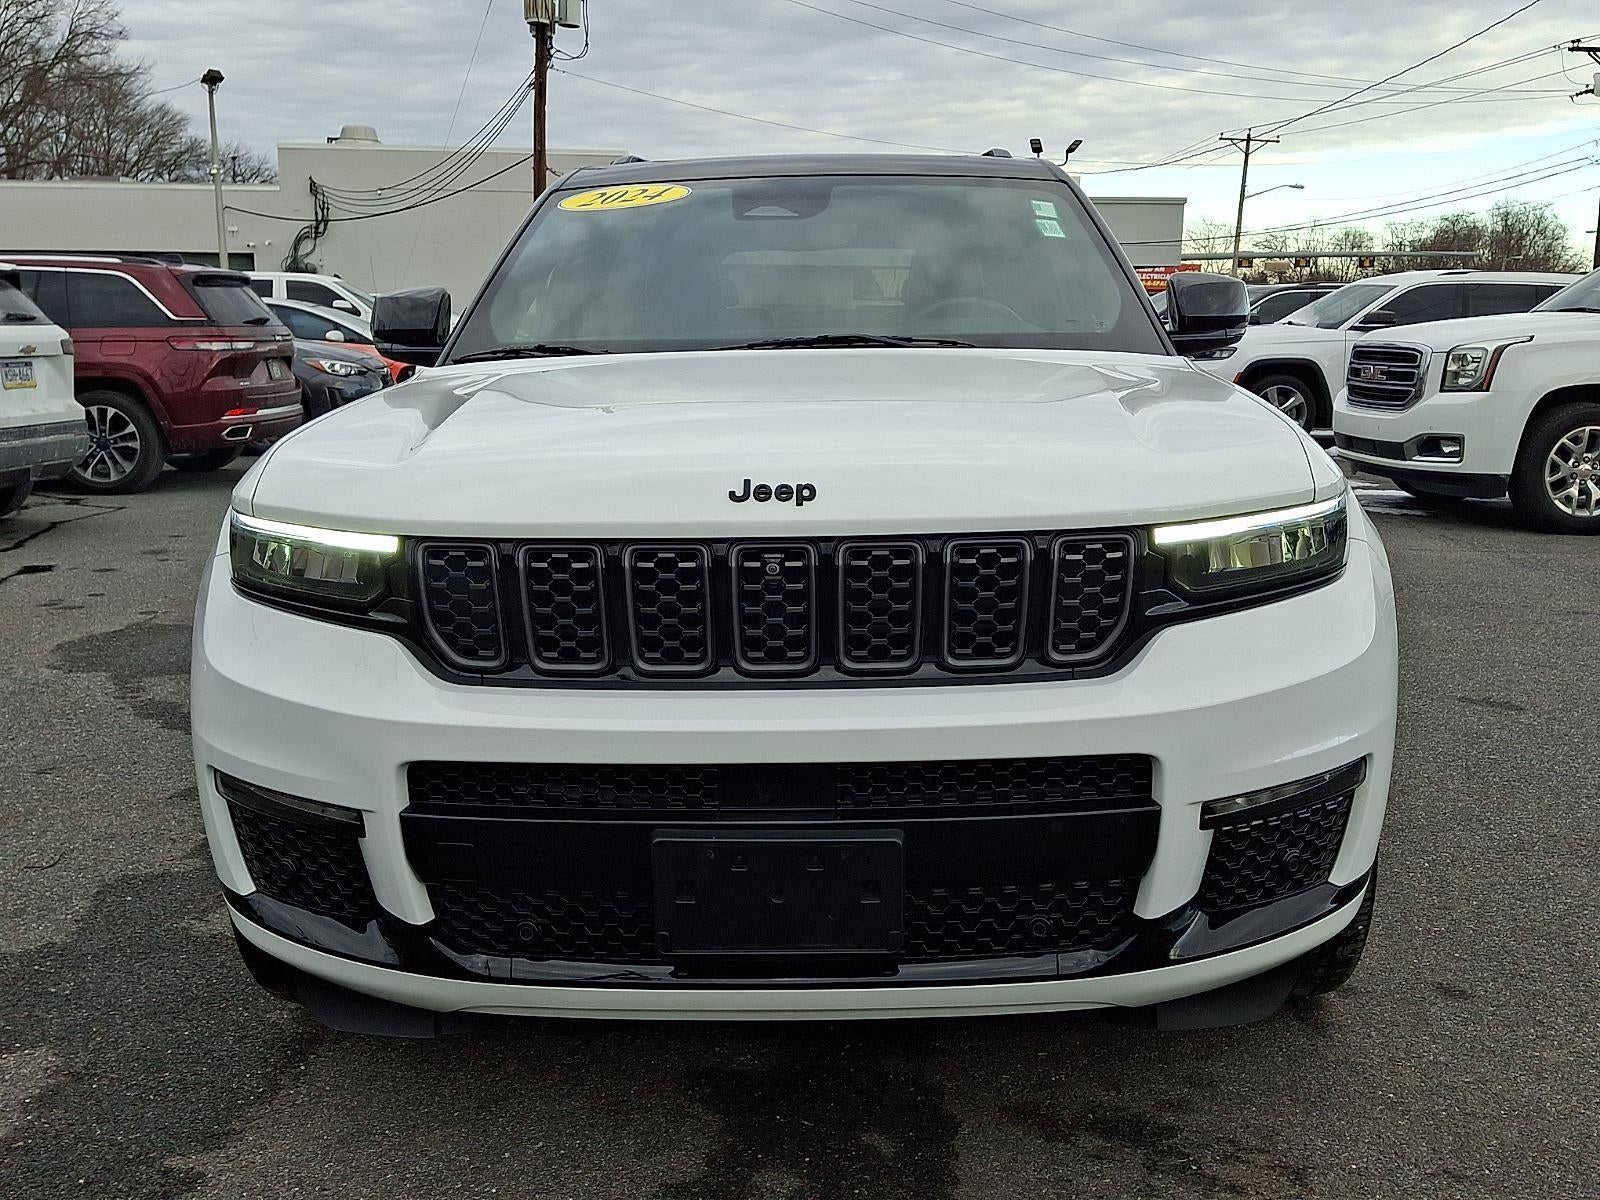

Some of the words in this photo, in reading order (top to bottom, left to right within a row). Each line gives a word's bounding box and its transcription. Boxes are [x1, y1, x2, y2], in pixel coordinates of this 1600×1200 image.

[575, 187, 674, 208] 2024
[1361, 365, 1388, 380] GMC
[728, 478, 817, 507] Jeep
